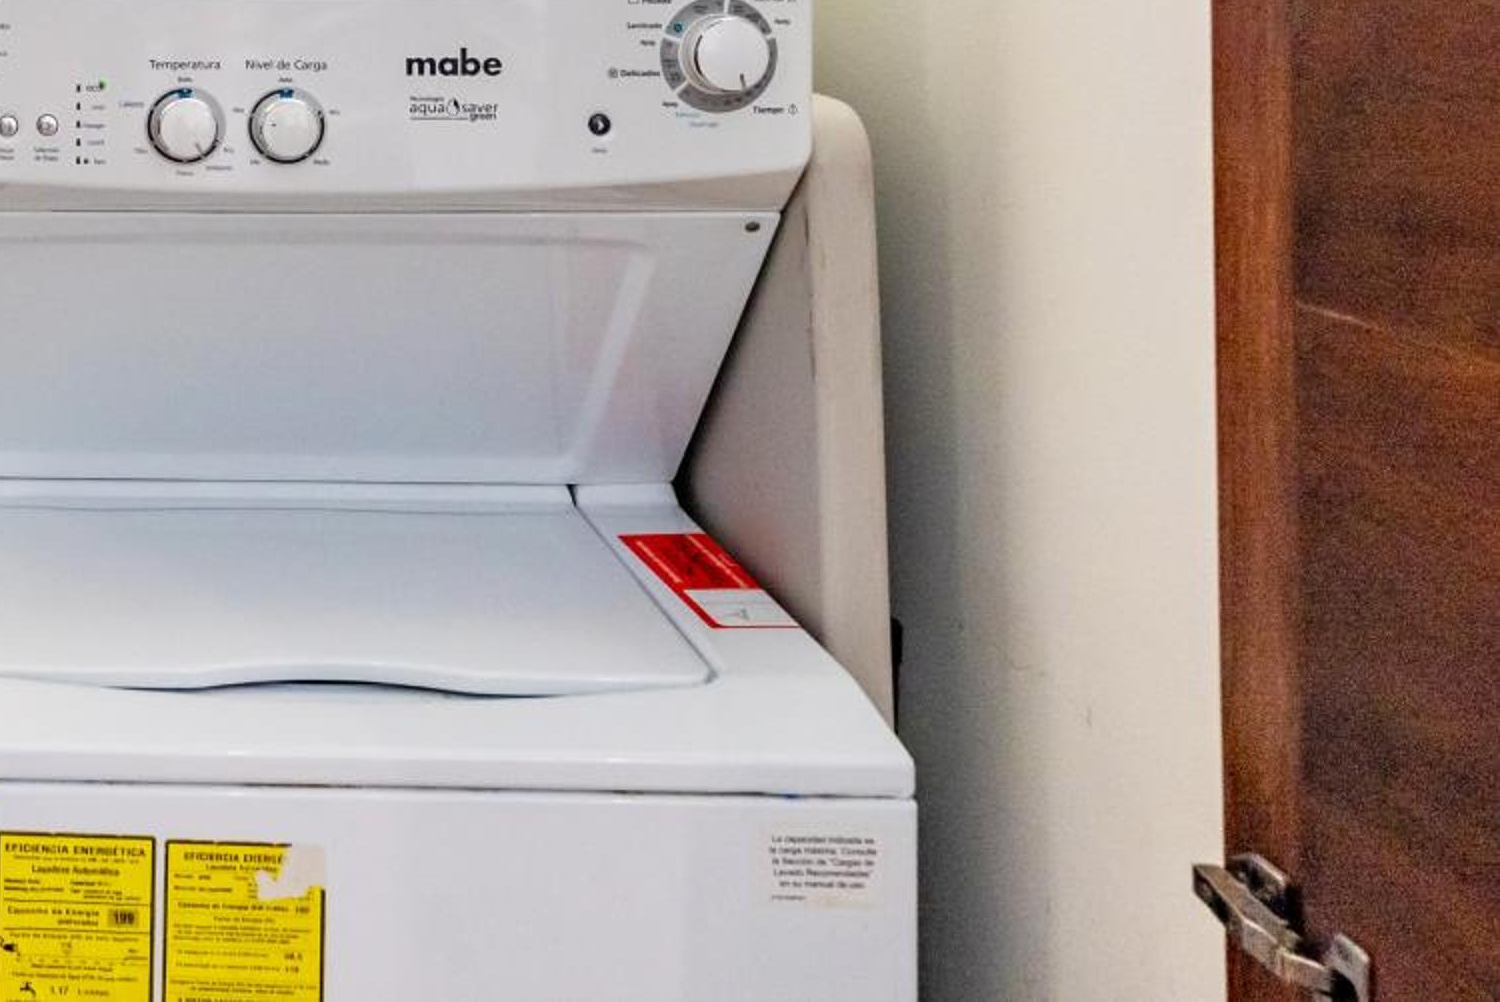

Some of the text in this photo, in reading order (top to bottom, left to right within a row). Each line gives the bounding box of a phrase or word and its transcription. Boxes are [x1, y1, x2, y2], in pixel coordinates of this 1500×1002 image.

[149, 59, 221, 71] Temperatura
[245, 59, 328, 72] Nivel de Carga
[406, 48, 503, 76] mabe
[409, 102, 499, 116] aqua saver
